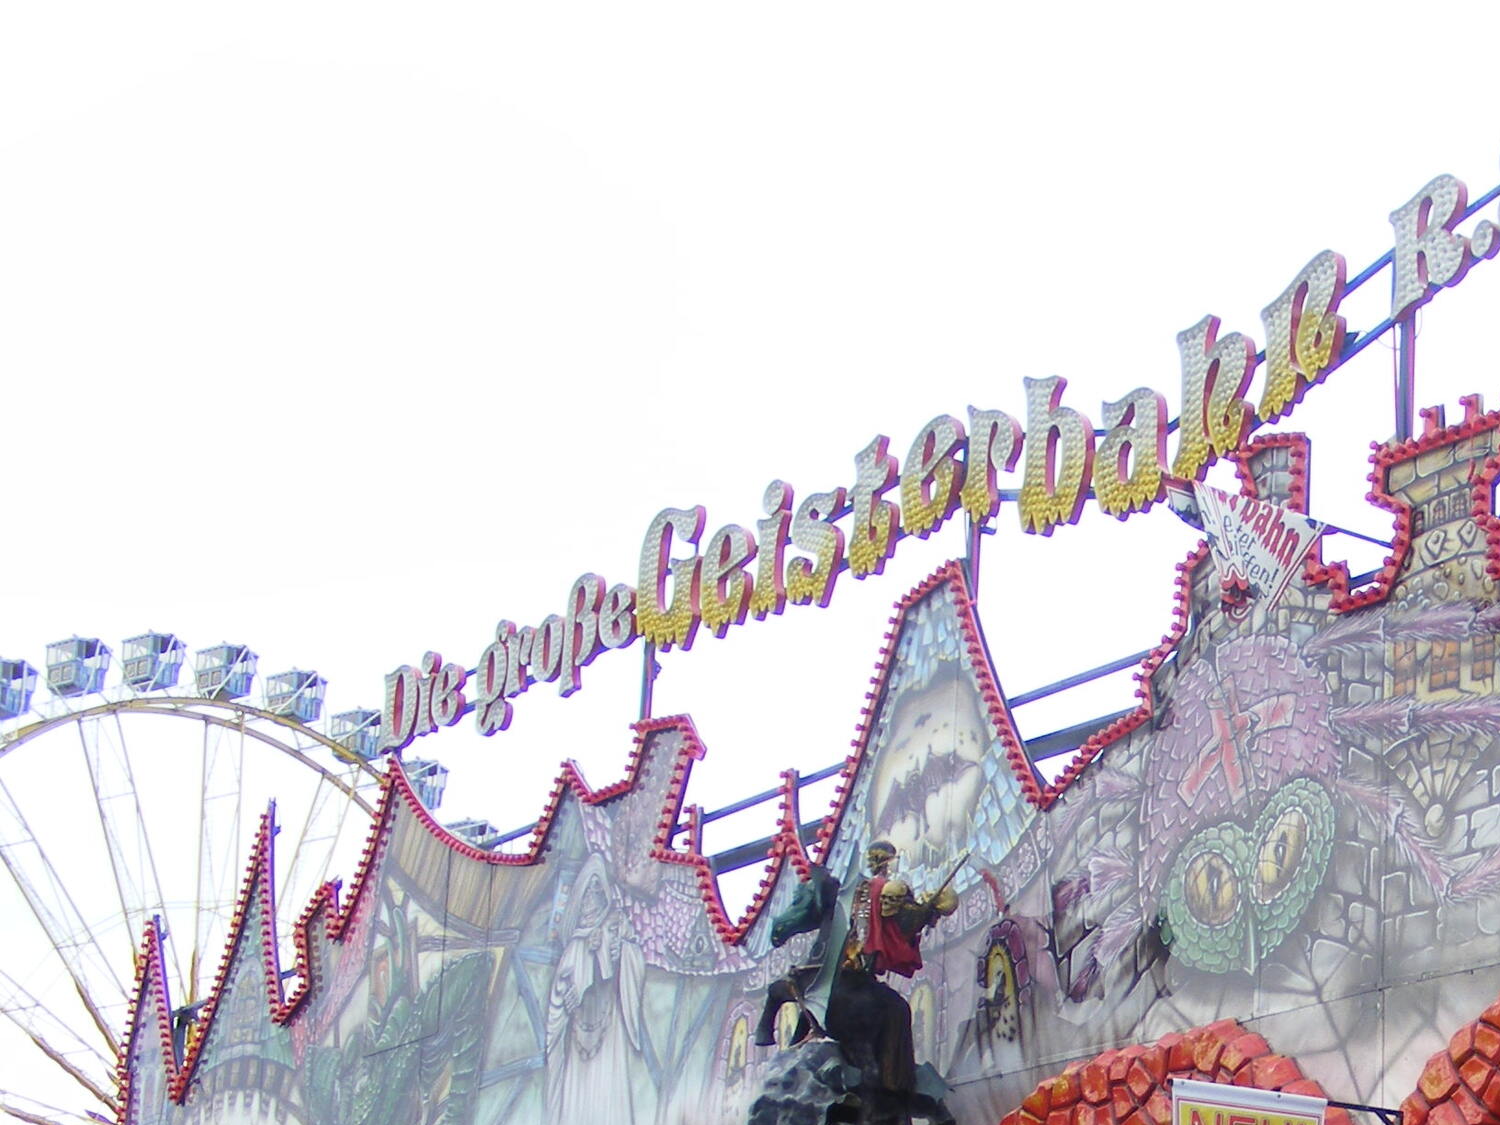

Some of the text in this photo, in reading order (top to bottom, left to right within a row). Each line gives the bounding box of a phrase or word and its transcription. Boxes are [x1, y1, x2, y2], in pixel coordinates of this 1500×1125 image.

[380, 651, 466, 754] Die
[474, 573, 639, 737] große
[636, 248, 1347, 652] Geisterbahn
